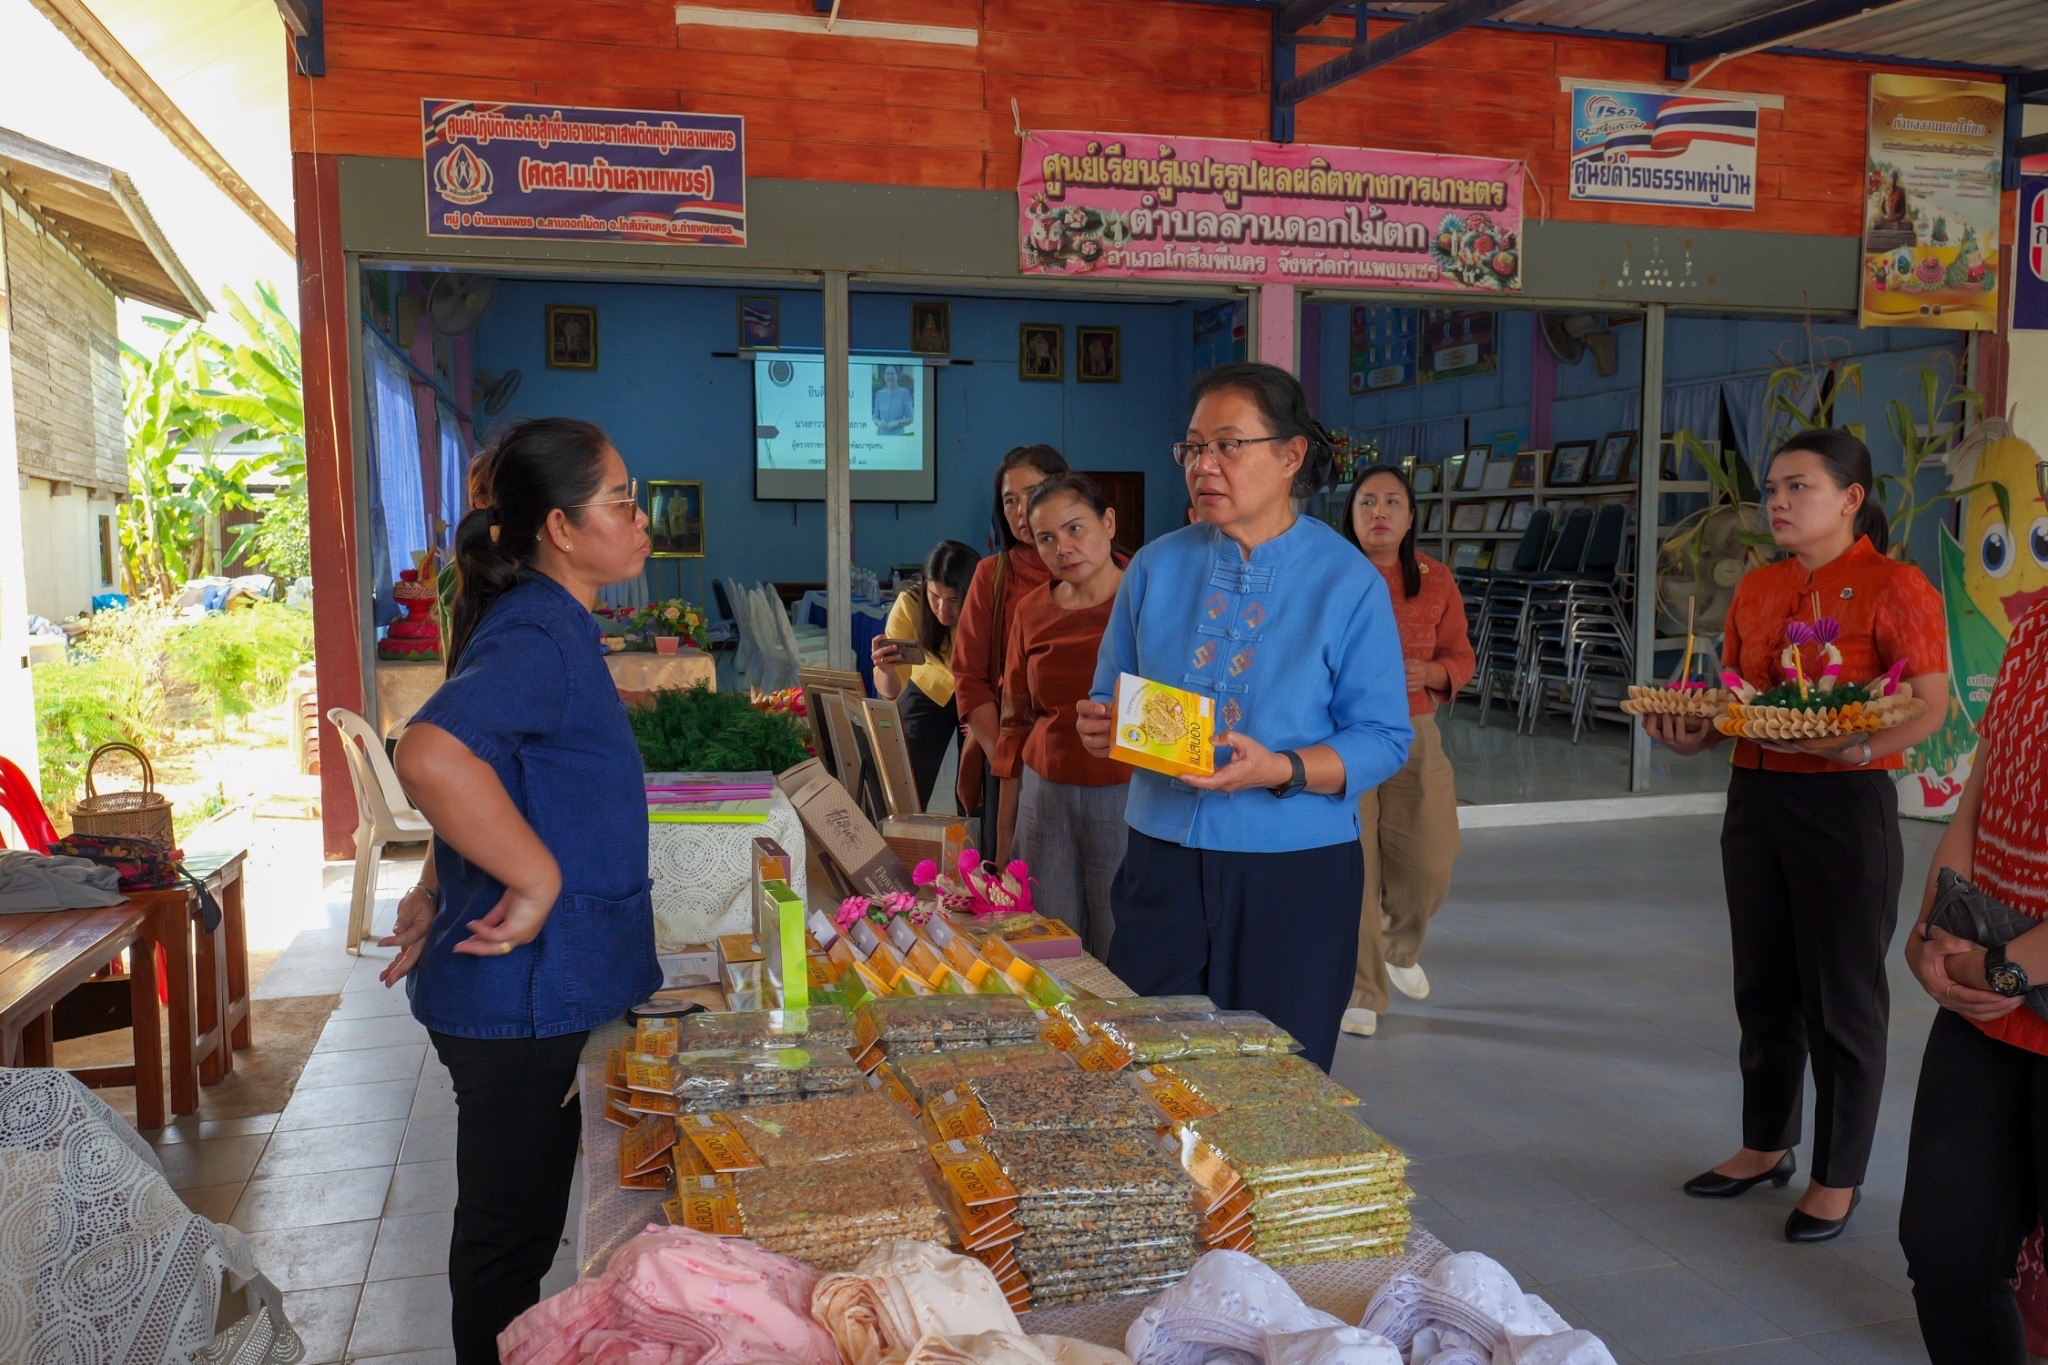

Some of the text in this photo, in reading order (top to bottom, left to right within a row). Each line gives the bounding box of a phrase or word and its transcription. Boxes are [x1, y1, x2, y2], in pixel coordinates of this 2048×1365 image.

[1595, 105, 1636, 118] 1567
[447, 112, 735, 153] ศูนย์ปฏิบัติการต่อสู้เพื่อเอาชนะยาเสพติดหมู่บ้านลานเพชร
[520, 157, 713, 198] (ศตส.ม.บ้านลานเพชร)
[1042, 142, 1507, 206] ศูนย์เรียนรู้แปรรูปผลผลิตทางการเกษตร
[1574, 153, 1751, 203] ศูนย์ดำรงธรรมหมู่บ้าน
[463, 214, 470, 225] 9
[474, 212, 533, 228] บ้านลานเพชร
[1130, 195, 1428, 249] ตำบลลานดอกไม้ตก
[1107, 244, 1439, 281] อำเภอโกสัมพีนคร จังหวัดกำแพงเพชร
